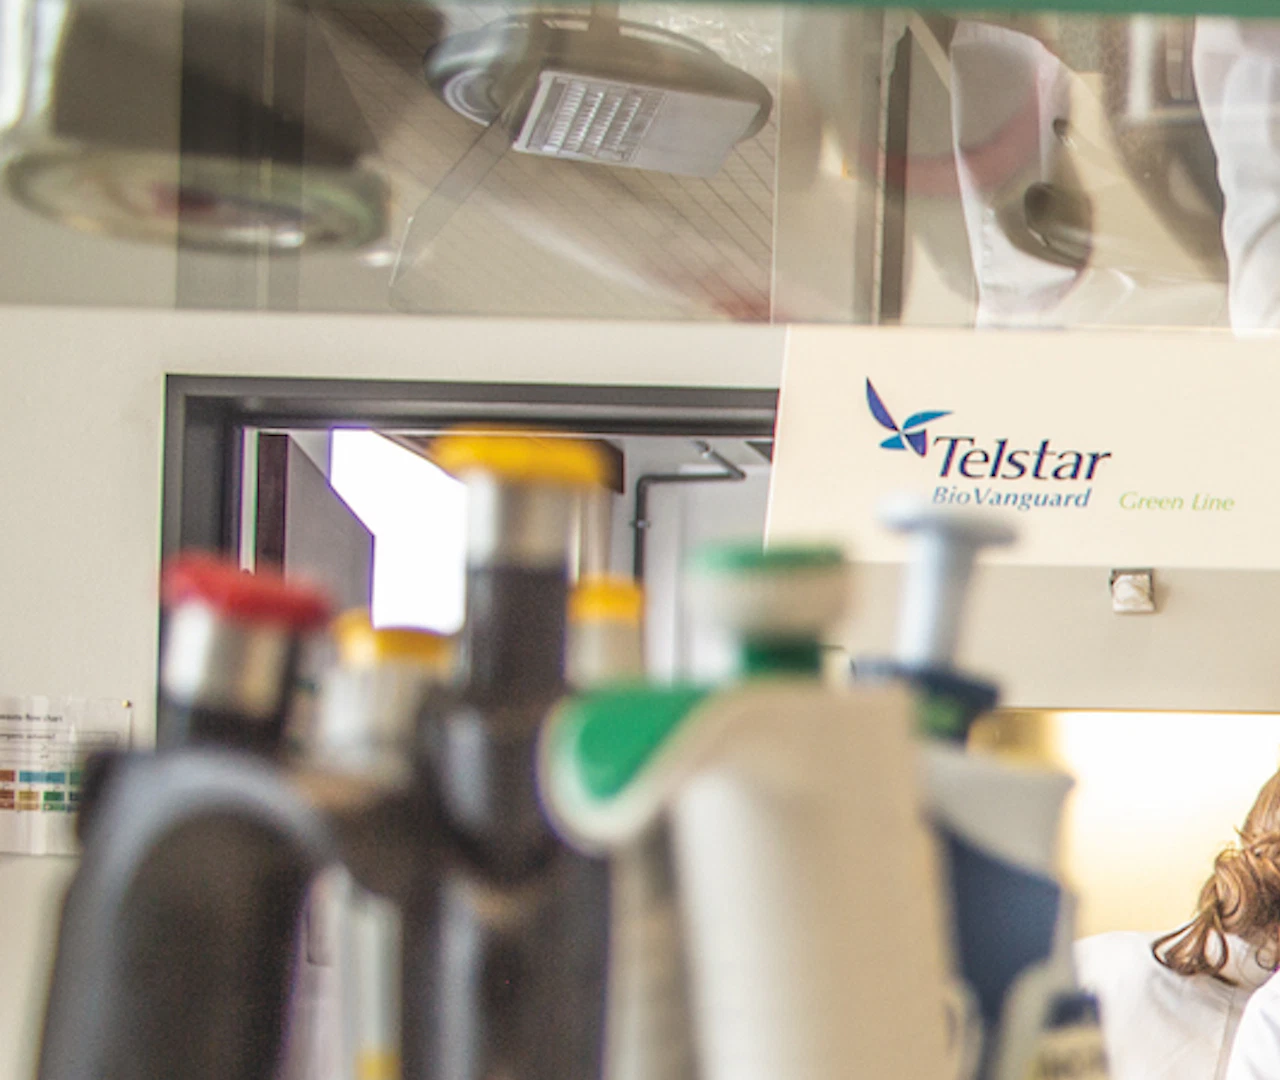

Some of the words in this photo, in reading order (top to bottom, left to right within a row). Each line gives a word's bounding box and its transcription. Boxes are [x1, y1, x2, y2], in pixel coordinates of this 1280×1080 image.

[933, 436, 1112, 481] Telstar
[931, 485, 1093, 511] BioVanguard
[1118, 490, 1184, 512] Green
[1191, 491, 1236, 512] Line
